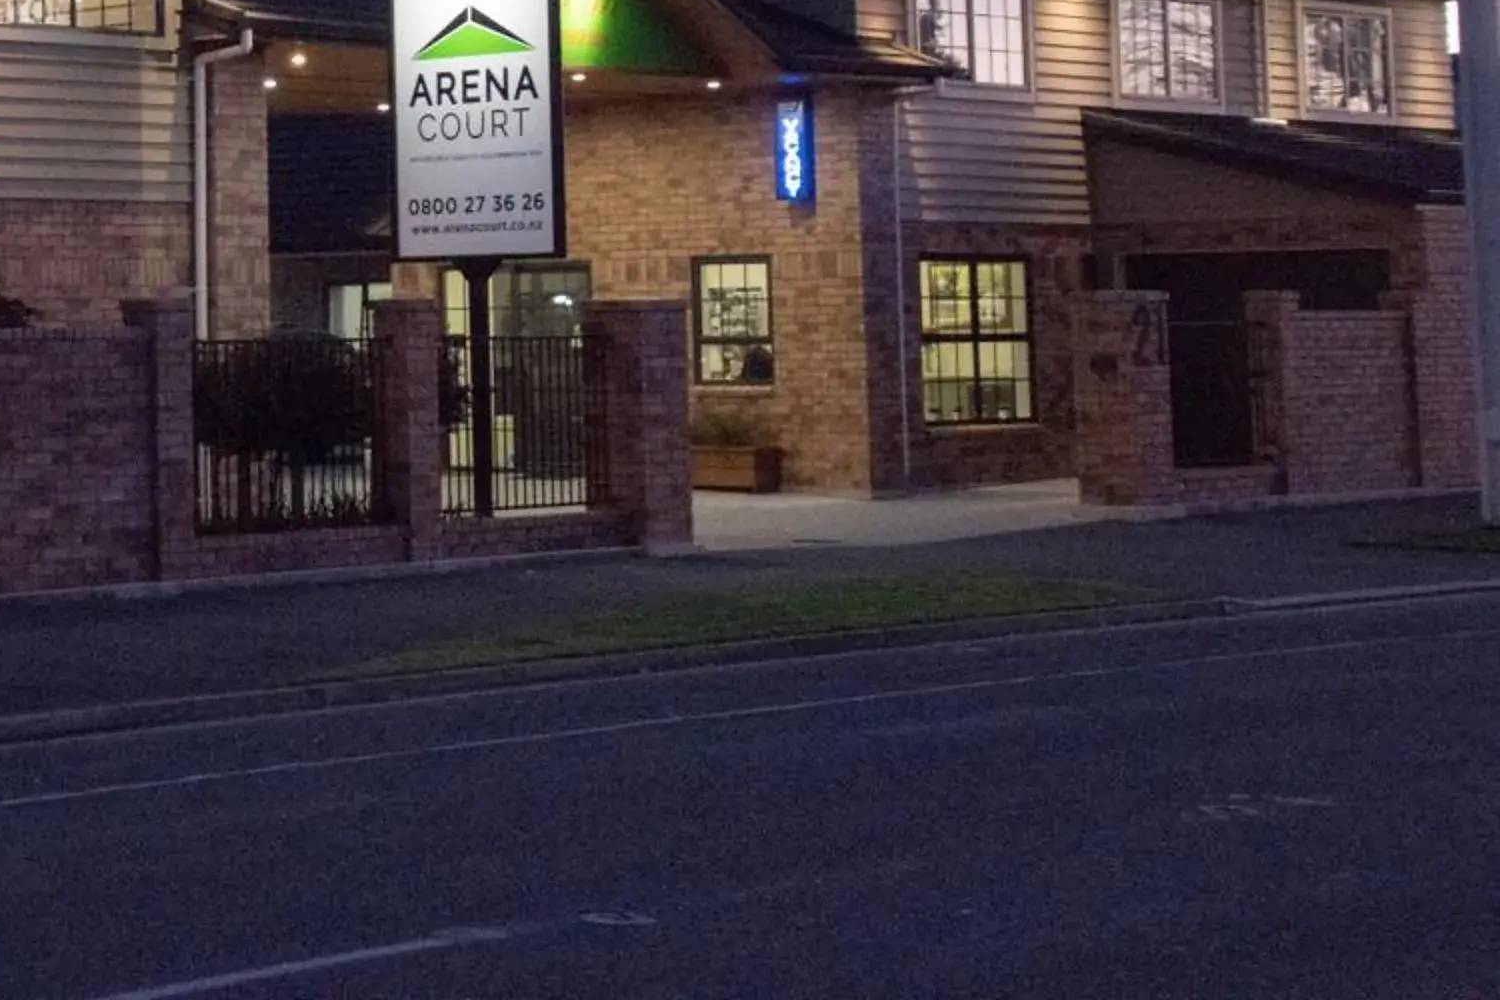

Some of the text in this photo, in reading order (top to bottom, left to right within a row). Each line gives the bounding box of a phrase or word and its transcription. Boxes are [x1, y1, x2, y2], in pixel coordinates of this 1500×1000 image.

[409, 65, 539, 107] ARENA
[417, 108, 531, 142] COURT
[408, 191, 545, 216] 0800 27 36 26
